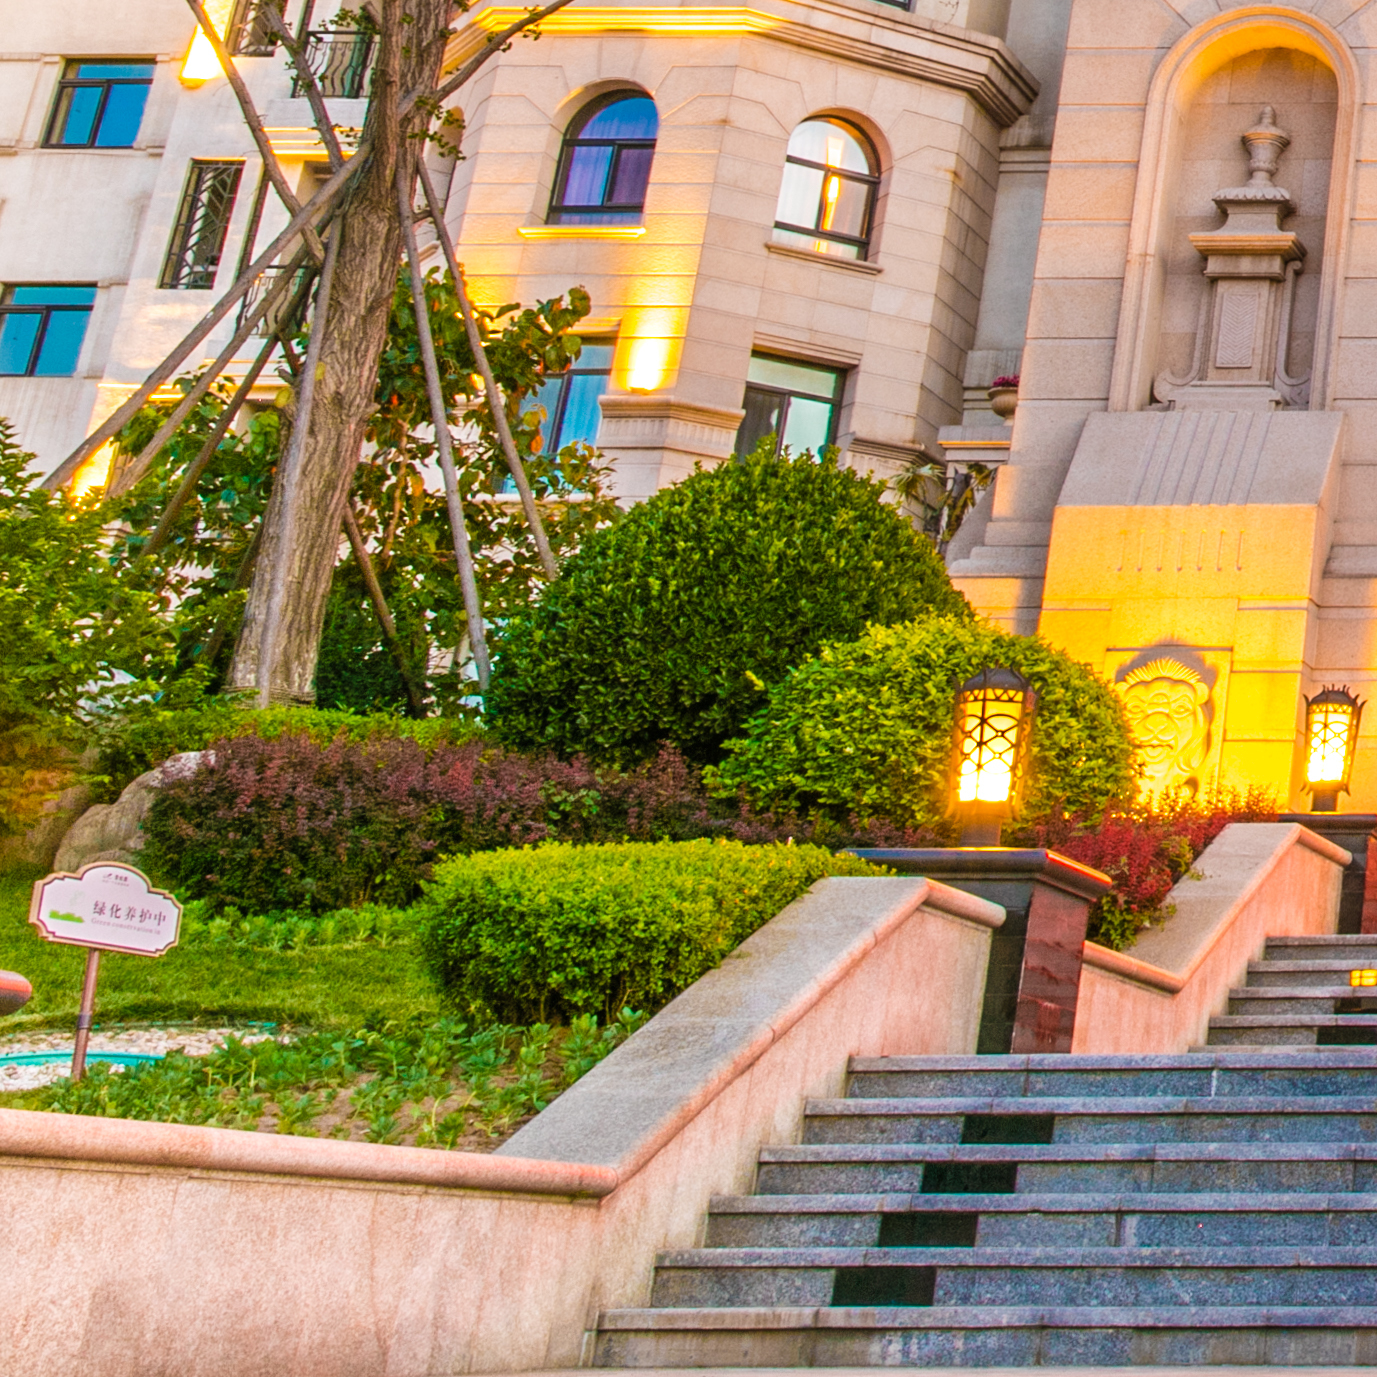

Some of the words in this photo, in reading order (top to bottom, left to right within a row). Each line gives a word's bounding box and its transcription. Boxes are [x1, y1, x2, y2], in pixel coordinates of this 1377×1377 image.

[93, 900, 166, 926] 绿化养护中
